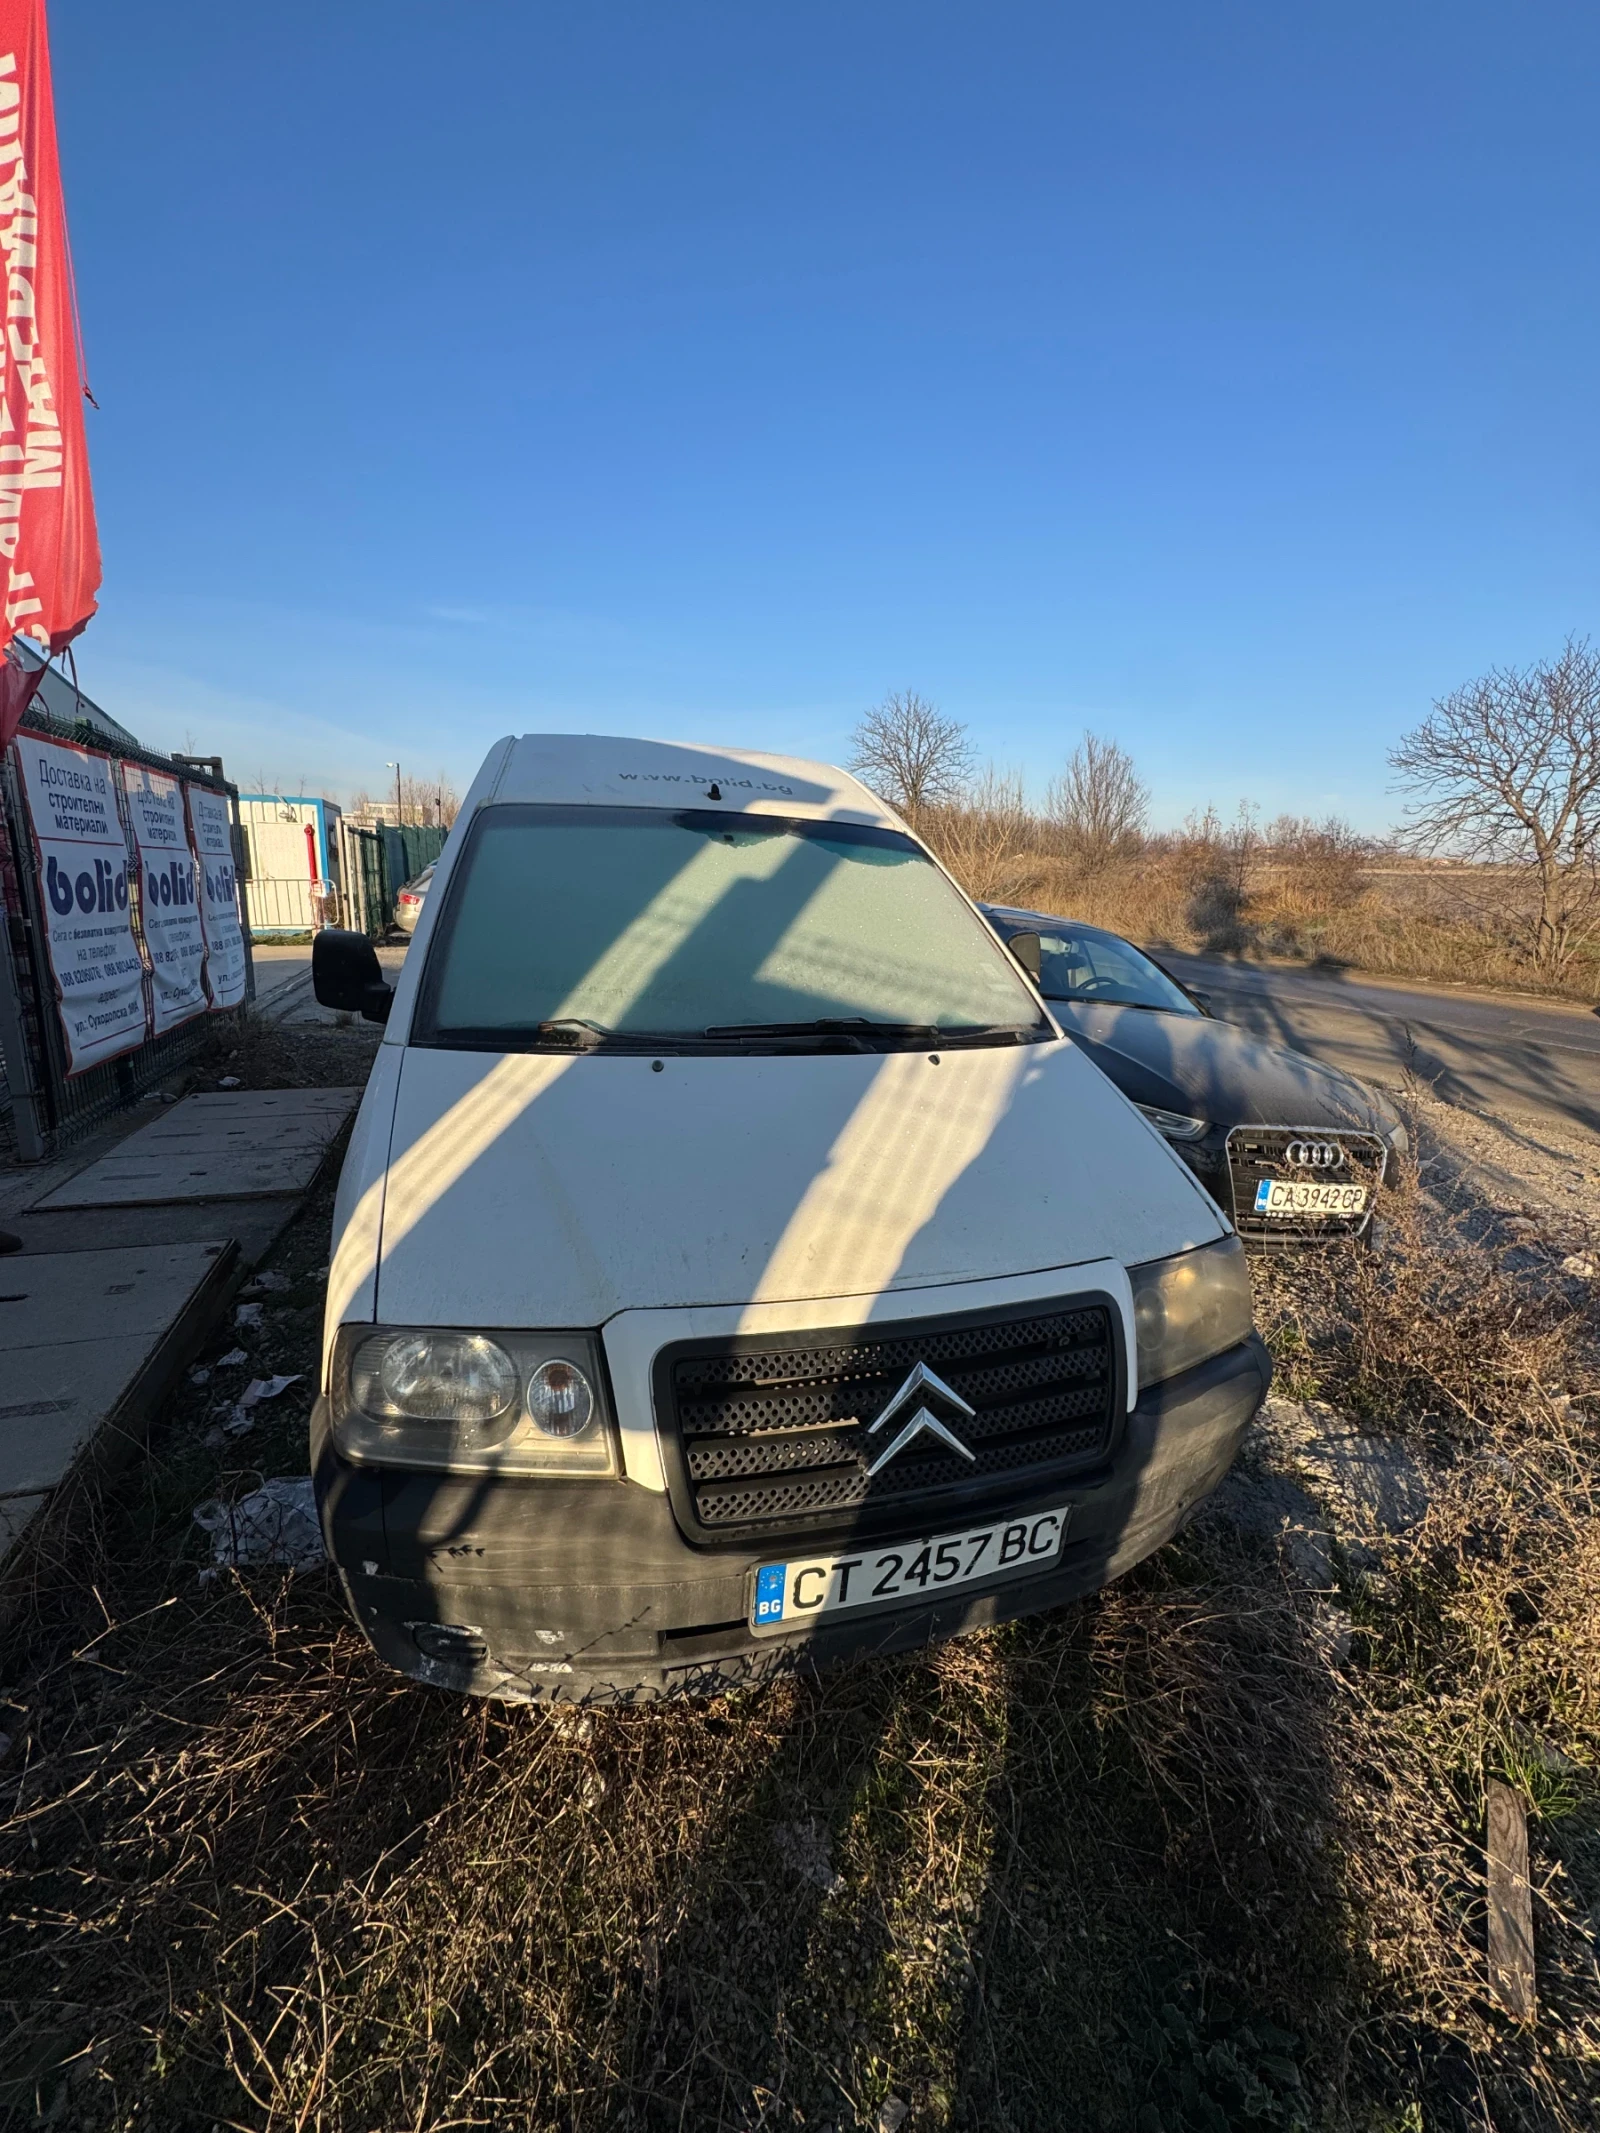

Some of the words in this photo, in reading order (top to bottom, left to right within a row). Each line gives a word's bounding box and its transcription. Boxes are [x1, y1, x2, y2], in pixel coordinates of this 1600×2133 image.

[39, 758, 92, 793] Доставка
[94, 778, 106, 795] на
[619, 772, 793, 795] www.bolid.bg
[48, 792, 105, 815] строителни
[54, 814, 109, 836] материали
[47, 856, 128, 916] bolid
[145, 860, 194, 907] bolid
[52, 930, 67, 942] Сега
[77, 949, 88, 962] на
[1271, 1186, 1294, 1207] CA
[1298, 1187, 1341, 1209] 3942
[758, 1599, 782, 1616] BG
[792, 1559, 863, 1610] CT
[871, 1532, 993, 1597] 2457
[998, 1515, 1058, 1565] BC
